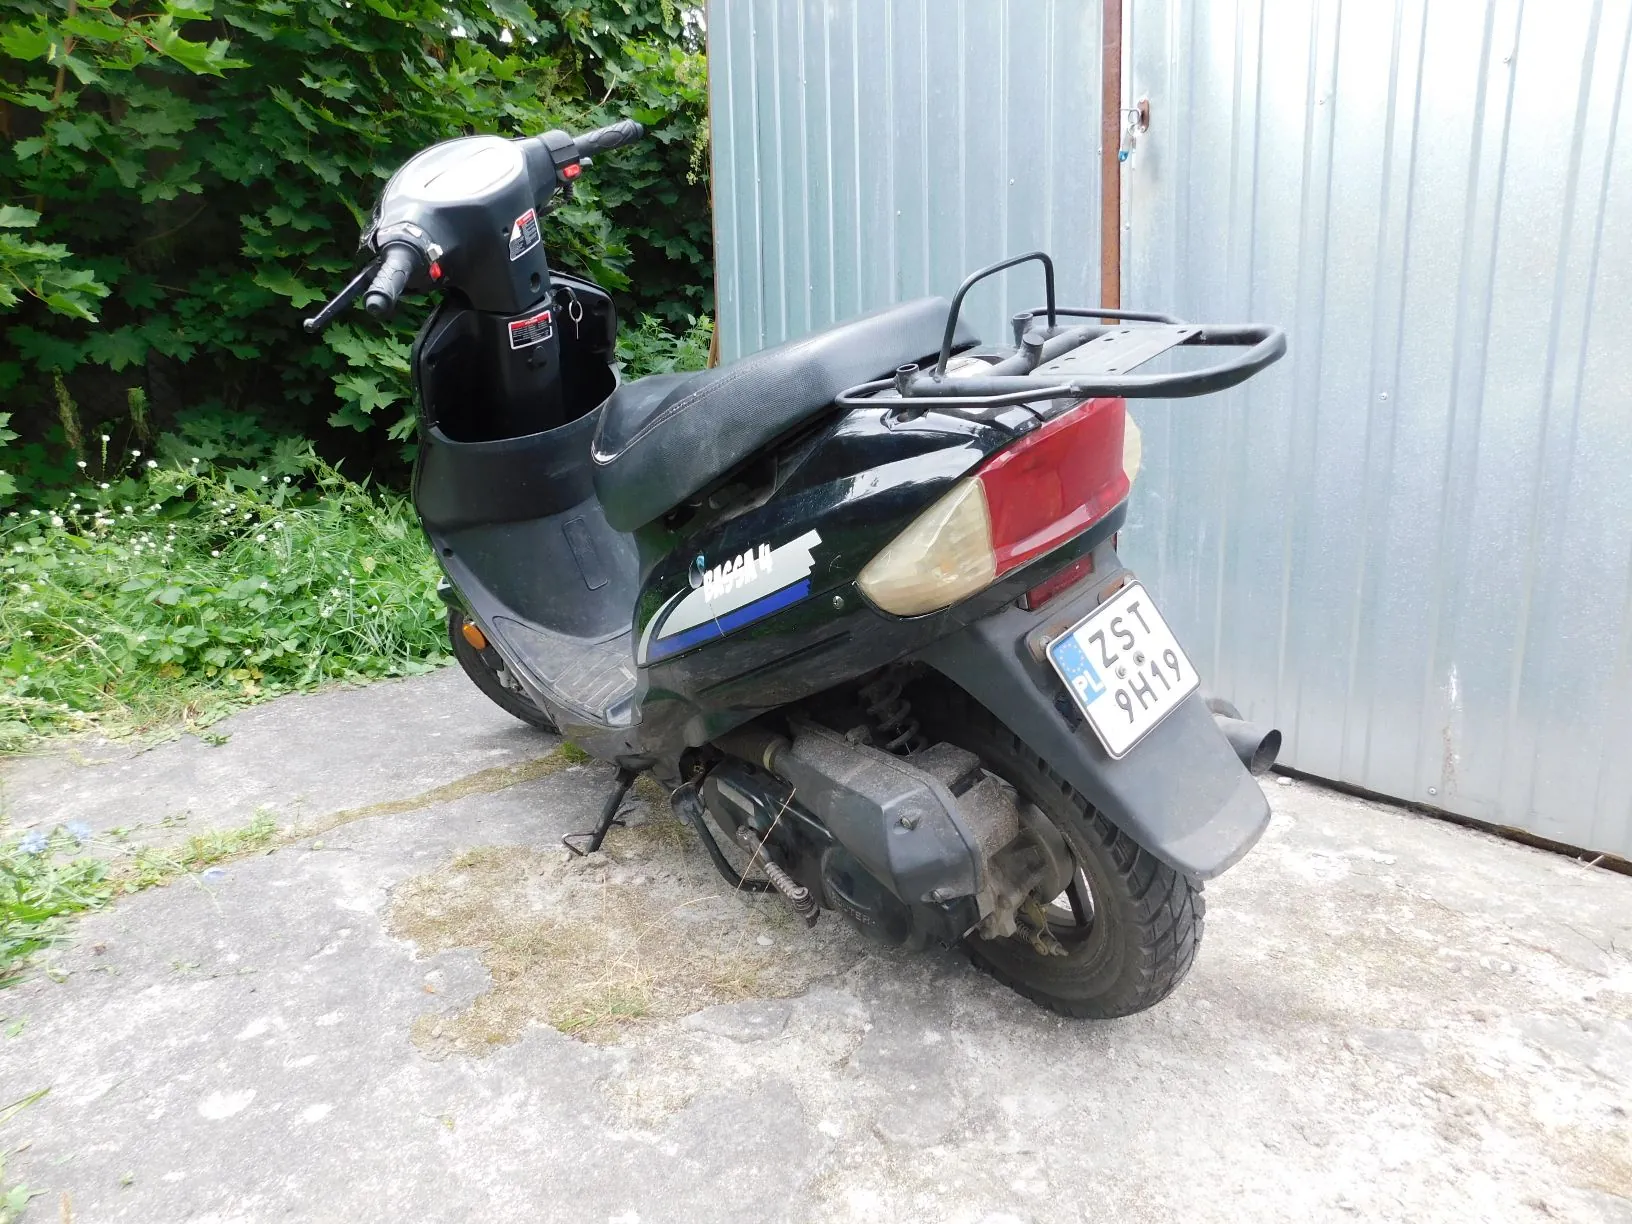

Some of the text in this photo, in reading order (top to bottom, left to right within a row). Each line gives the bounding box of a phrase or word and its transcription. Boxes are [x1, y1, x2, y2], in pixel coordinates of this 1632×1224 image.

[759, 543, 773, 575] 4
[1088, 601, 1151, 668] ZST
[1071, 670, 1106, 702] PL
[1115, 649, 1181, 723] 9H19
